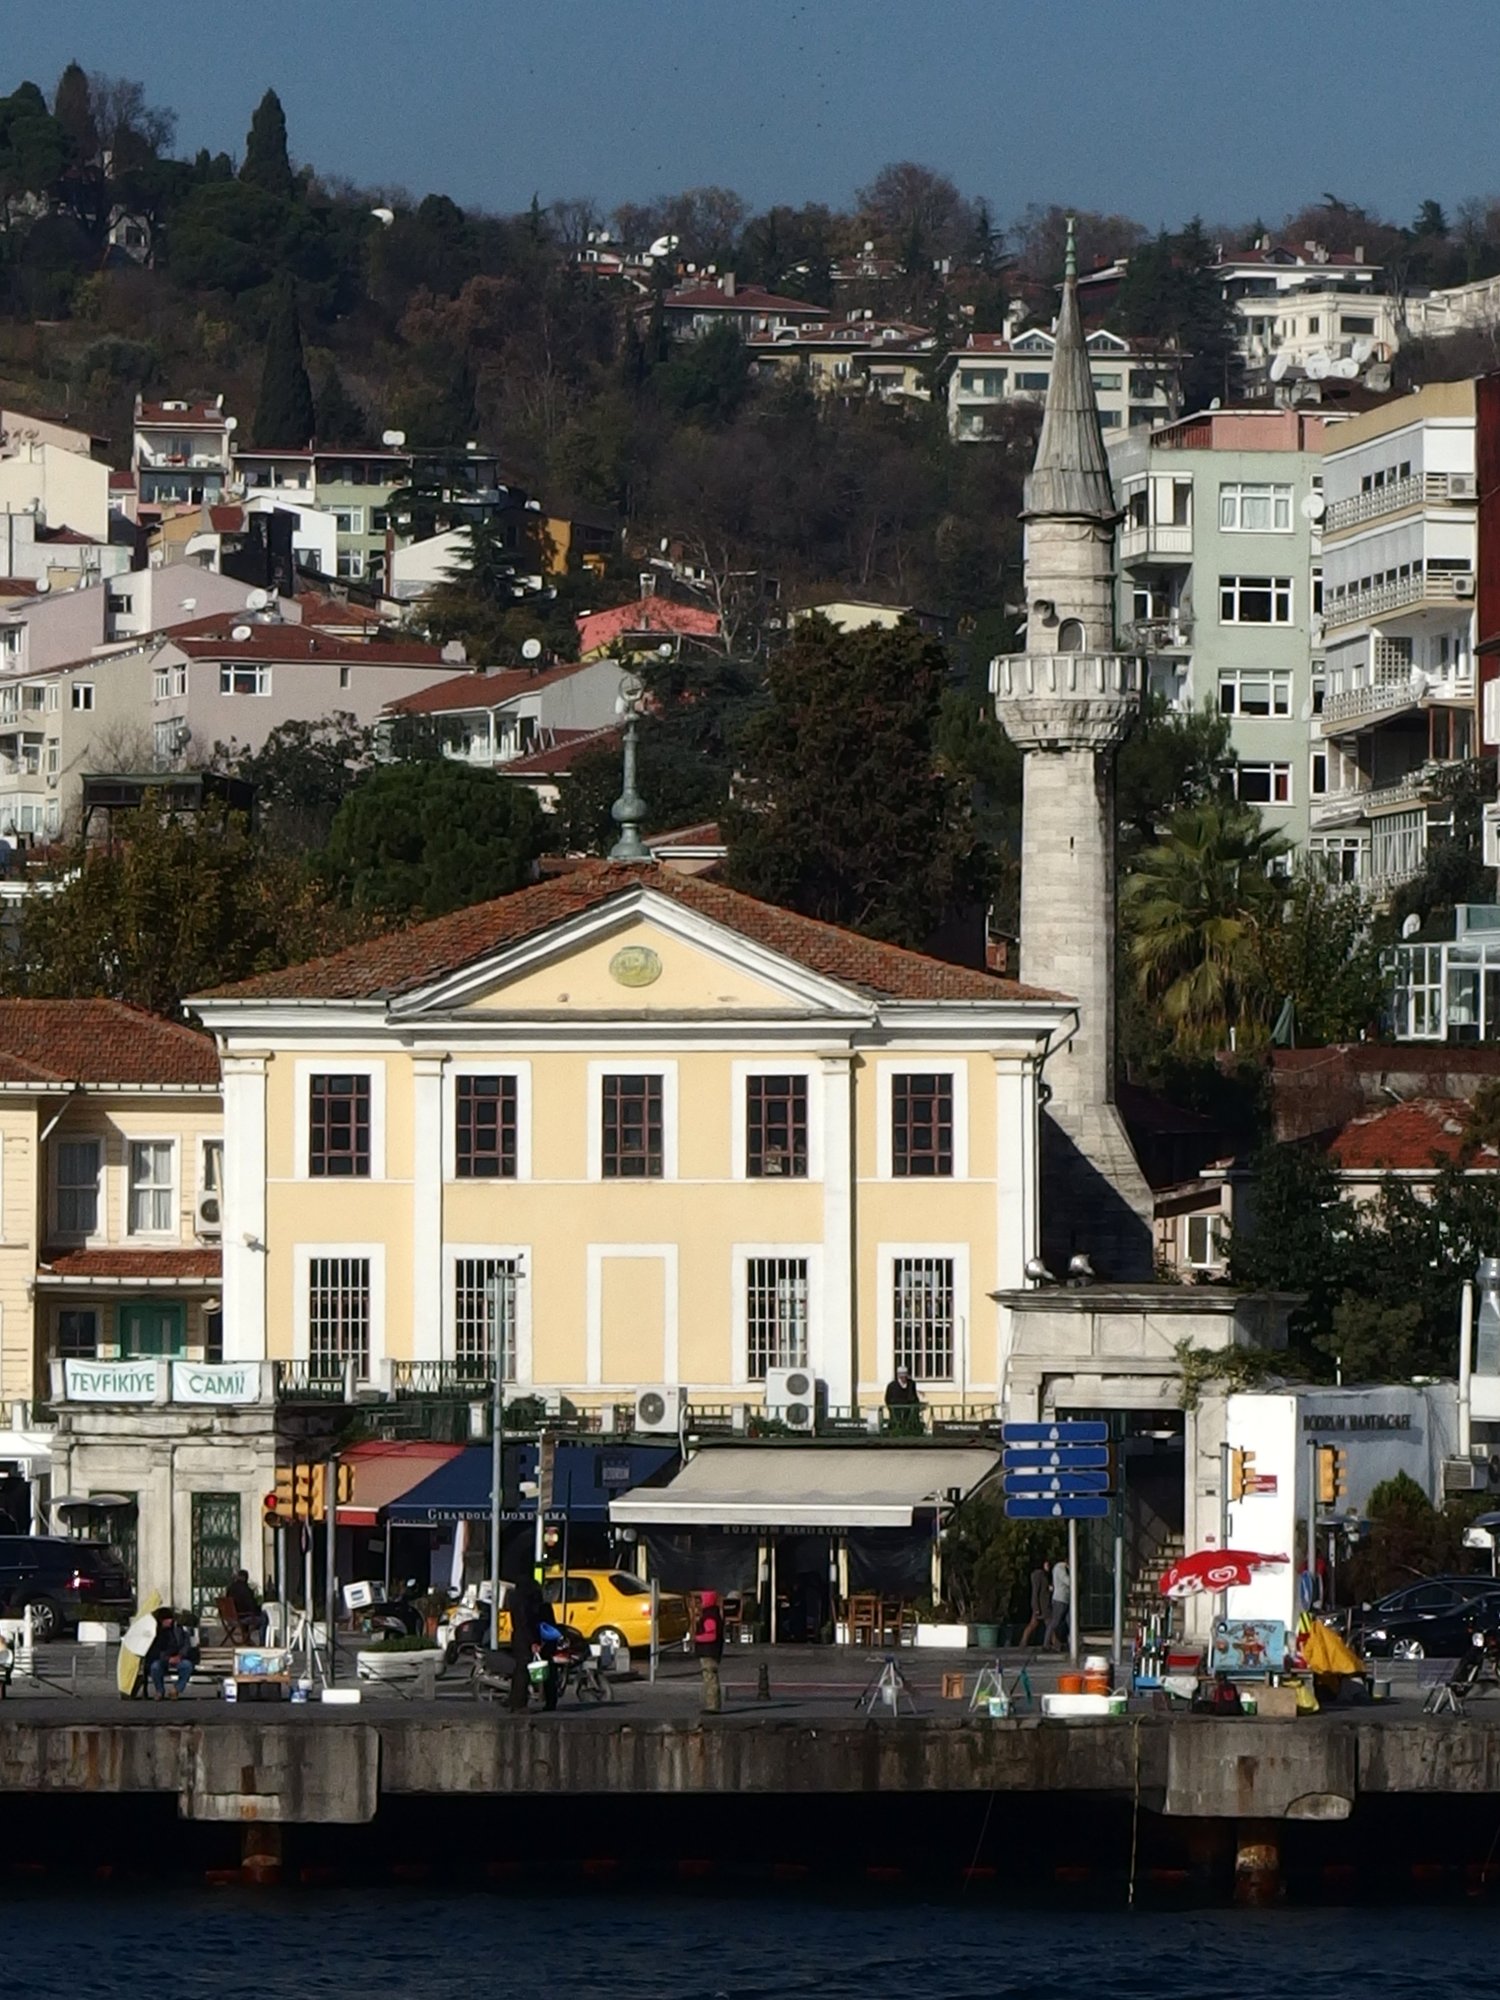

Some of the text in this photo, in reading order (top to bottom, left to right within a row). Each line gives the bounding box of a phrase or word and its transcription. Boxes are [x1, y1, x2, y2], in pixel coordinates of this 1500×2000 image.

[70, 1368, 245, 1395] TEVFİKİYE CAMİİ
[501, 1509, 567, 1521] DONDRMA
